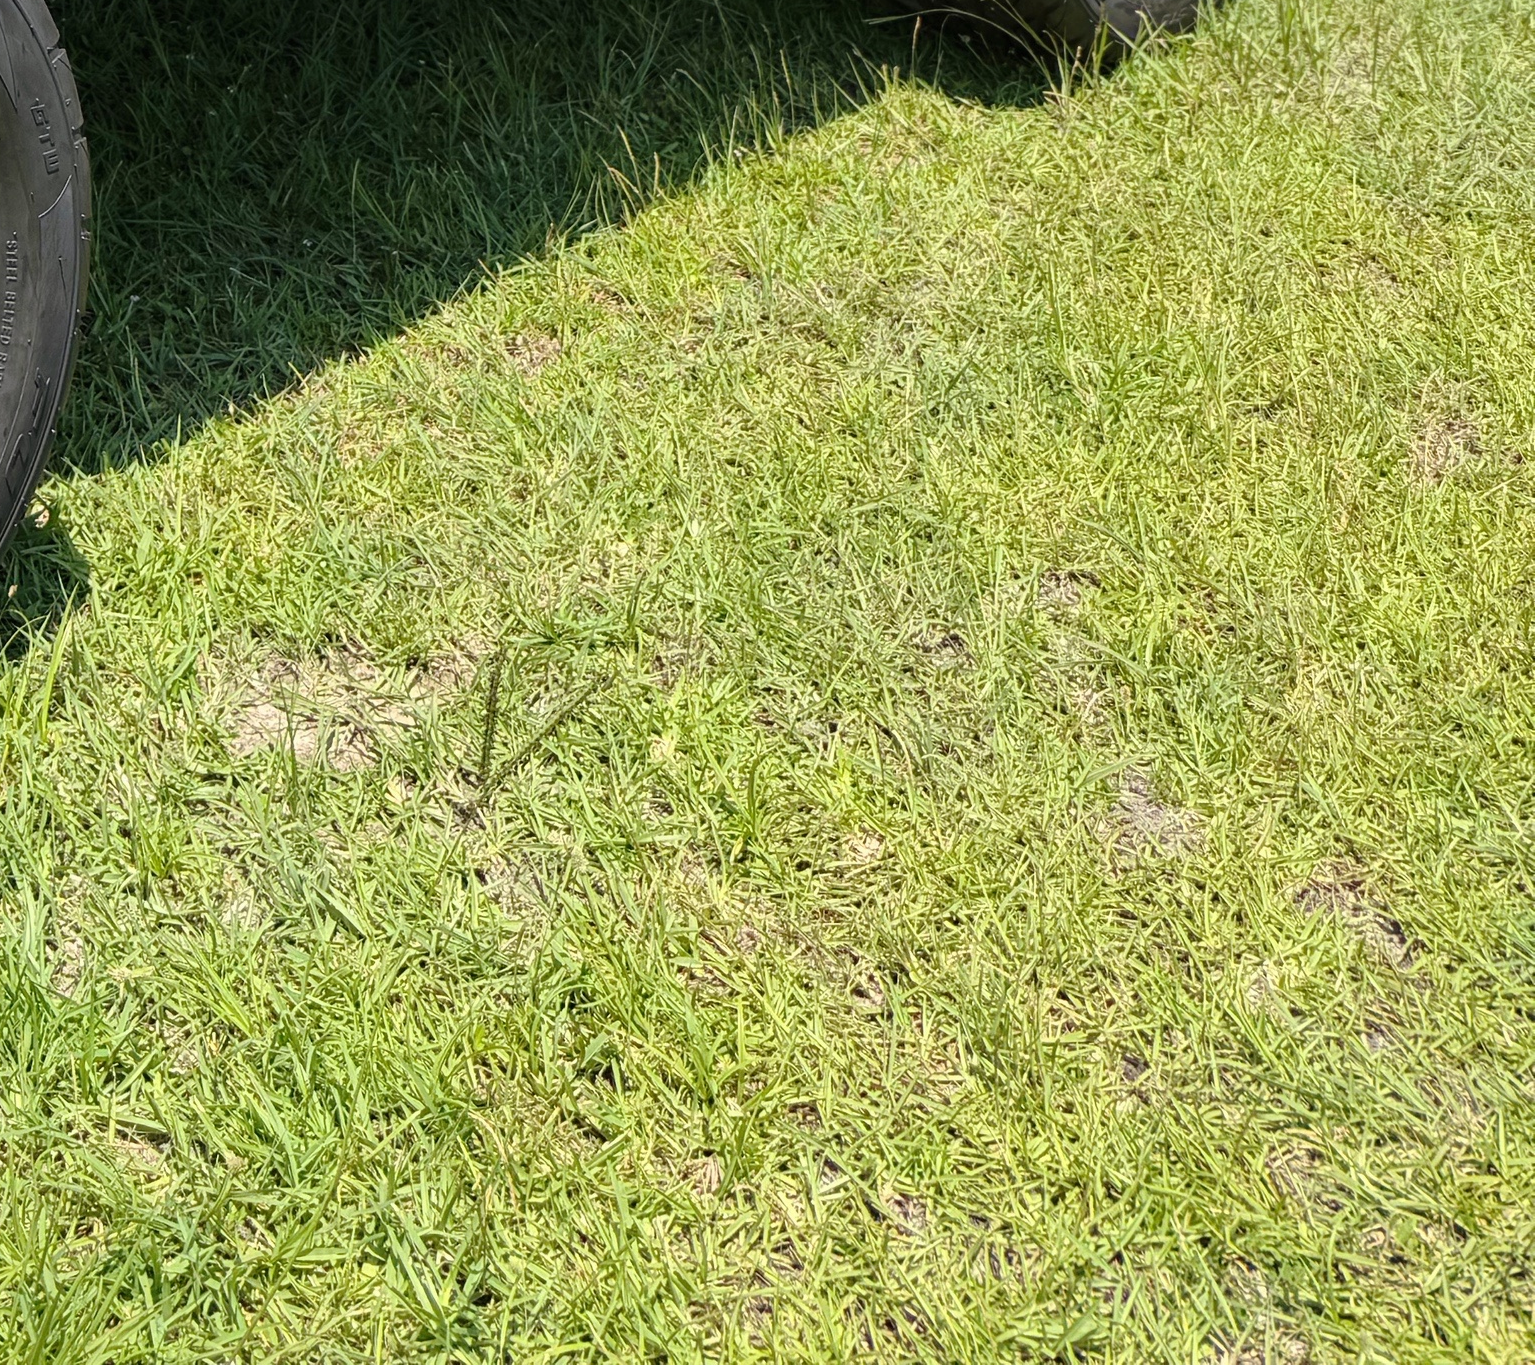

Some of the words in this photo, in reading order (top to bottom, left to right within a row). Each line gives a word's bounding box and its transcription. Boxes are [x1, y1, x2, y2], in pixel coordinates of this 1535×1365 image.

[29, 103, 62, 175] GTW
[5, 239, 19, 284] STEEL
[0, 291, 16, 345] BELTED
